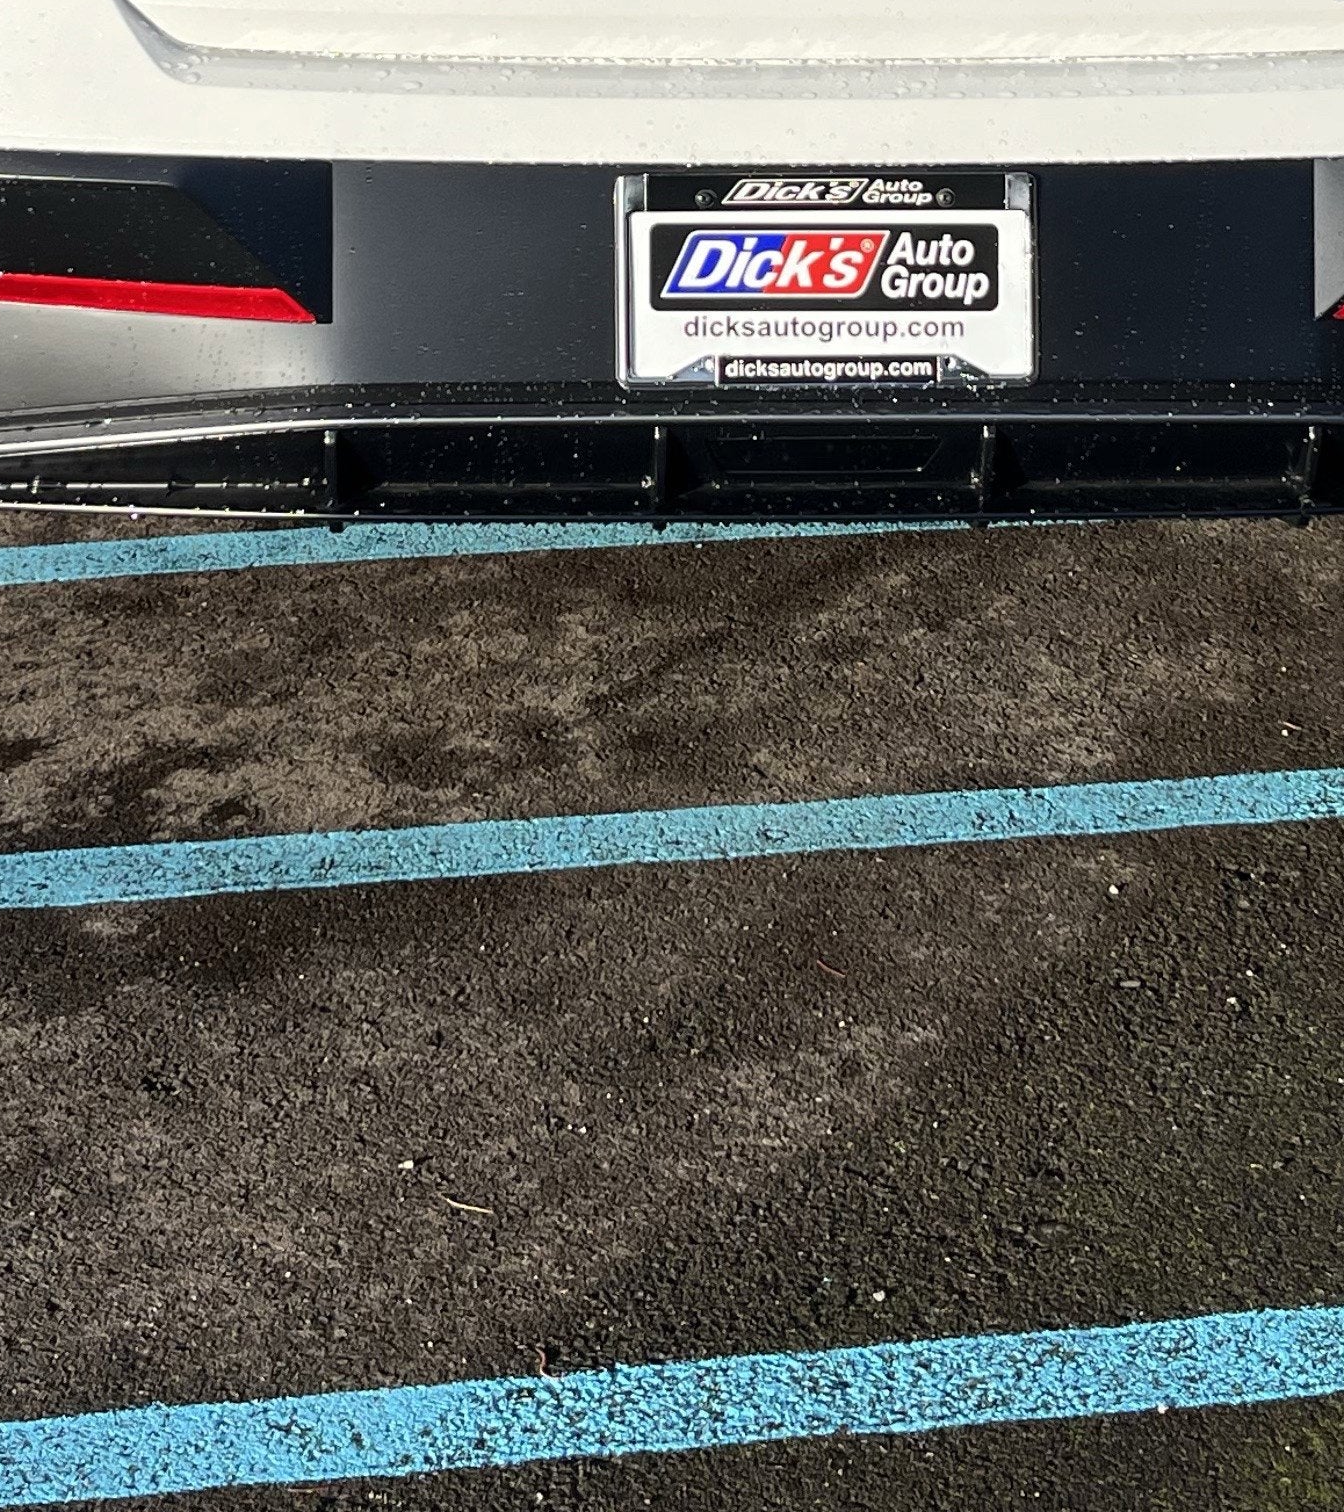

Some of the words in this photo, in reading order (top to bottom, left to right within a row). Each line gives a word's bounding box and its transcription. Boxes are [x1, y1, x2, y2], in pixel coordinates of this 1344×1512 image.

[733, 179, 853, 202] Dick's
[861, 189, 933, 206] Group
[867, 178, 924, 192] Auto
[886, 231, 975, 266] Auto
[677, 236, 865, 289] Dick's
[880, 264, 990, 306] Group
[683, 315, 966, 342] dicksautogroup.com
[723, 358, 933, 381] dicksautogroup.com
